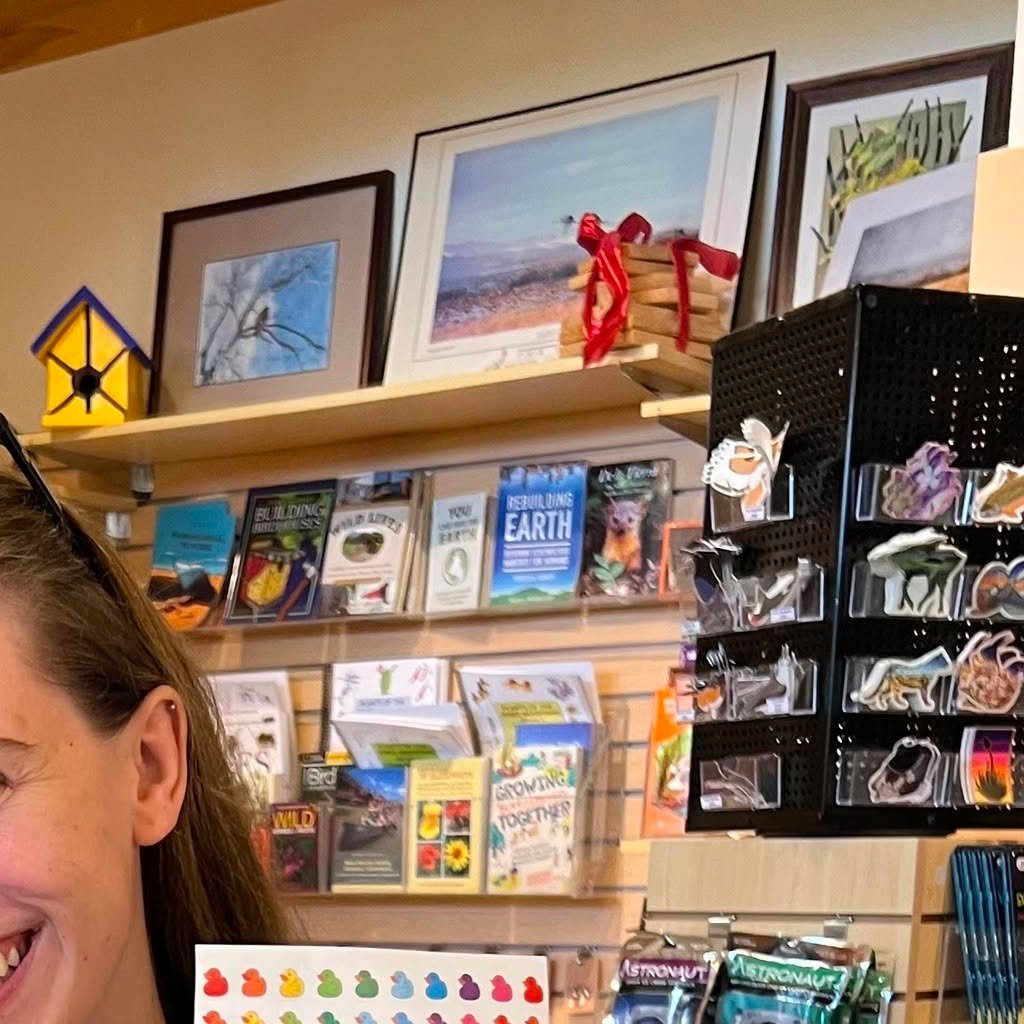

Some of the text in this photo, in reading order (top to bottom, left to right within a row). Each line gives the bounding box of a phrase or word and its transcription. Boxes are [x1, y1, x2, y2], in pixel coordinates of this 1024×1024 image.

[504, 509, 573, 542] EARTH
[496, 776, 566, 801] GROWING
[273, 809, 316, 829] WILD
[499, 801, 570, 831] TOGETHER
[620, 958, 708, 982] ASTRONAUT
[730, 955, 835, 991] ASTRONAUT
